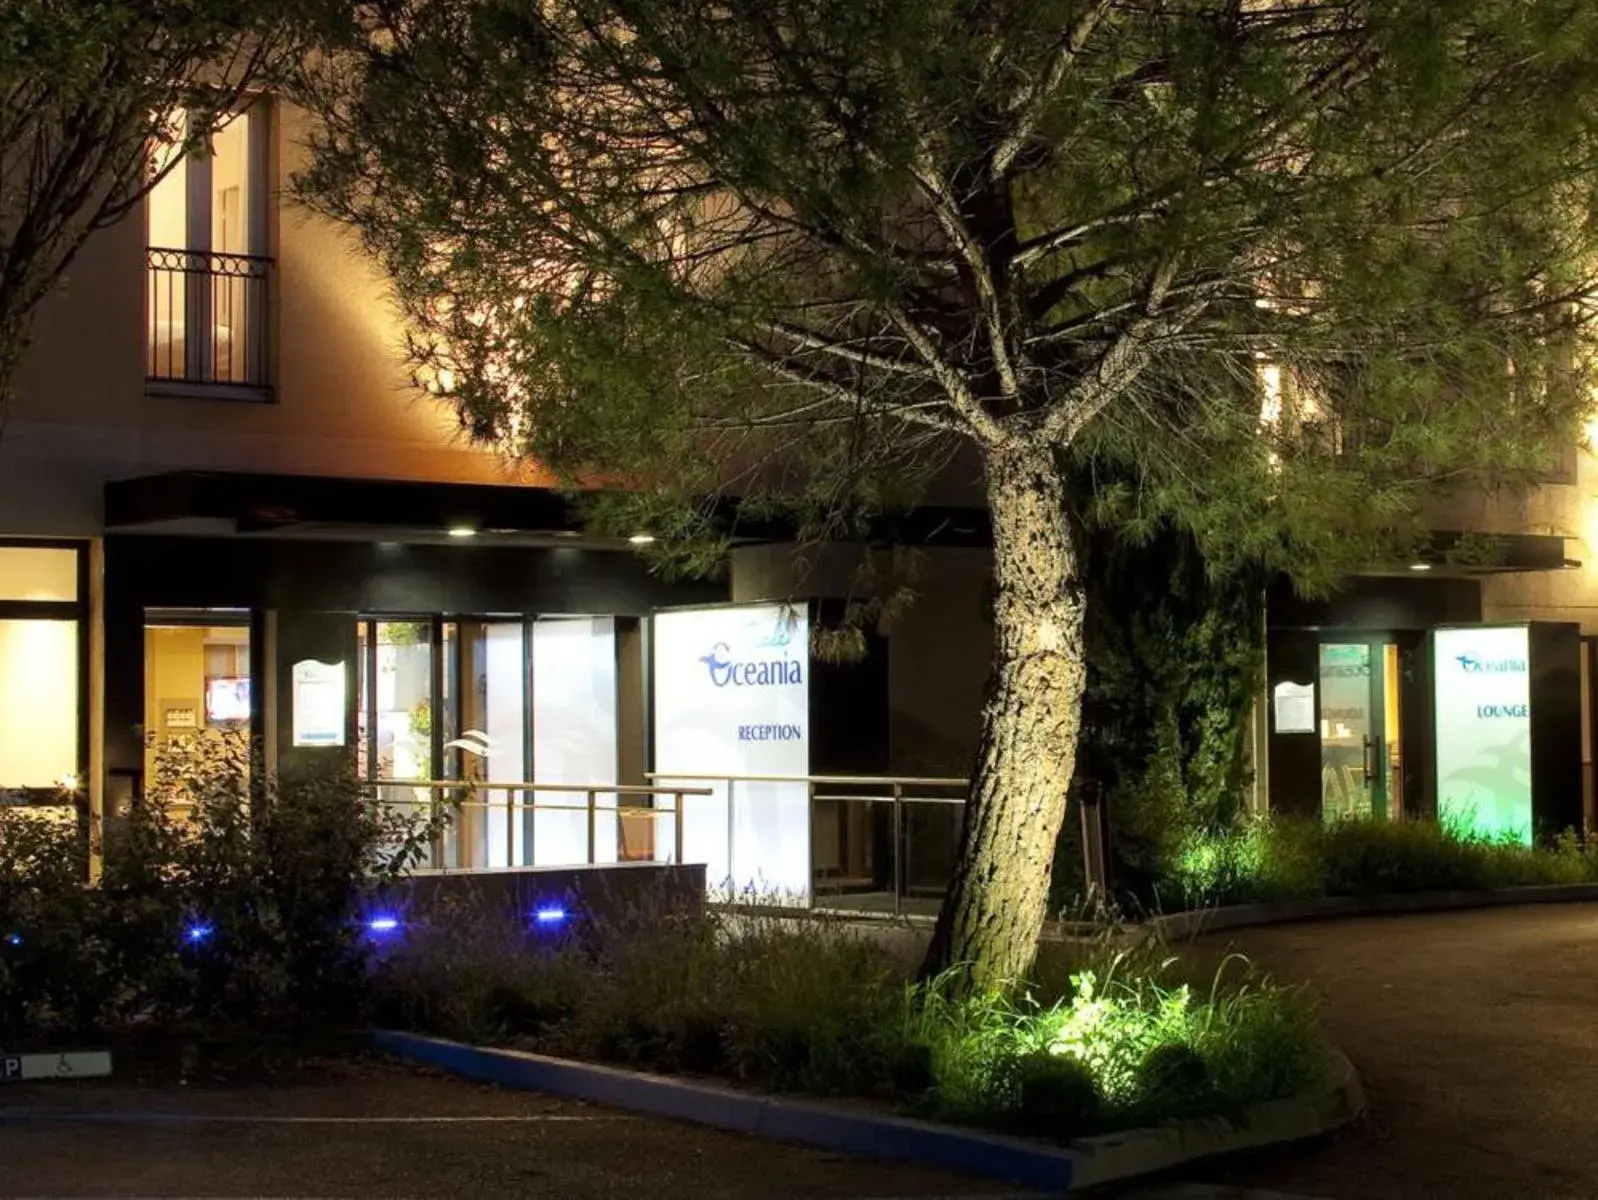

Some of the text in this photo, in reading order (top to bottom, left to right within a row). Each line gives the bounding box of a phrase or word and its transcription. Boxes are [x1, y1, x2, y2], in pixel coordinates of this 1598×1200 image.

[700, 642, 802, 687] Oceania
[1477, 704, 1528, 719] LOUNGE
[738, 724, 802, 741] RECEPTION
[5, 1059, 18, 1076] P
